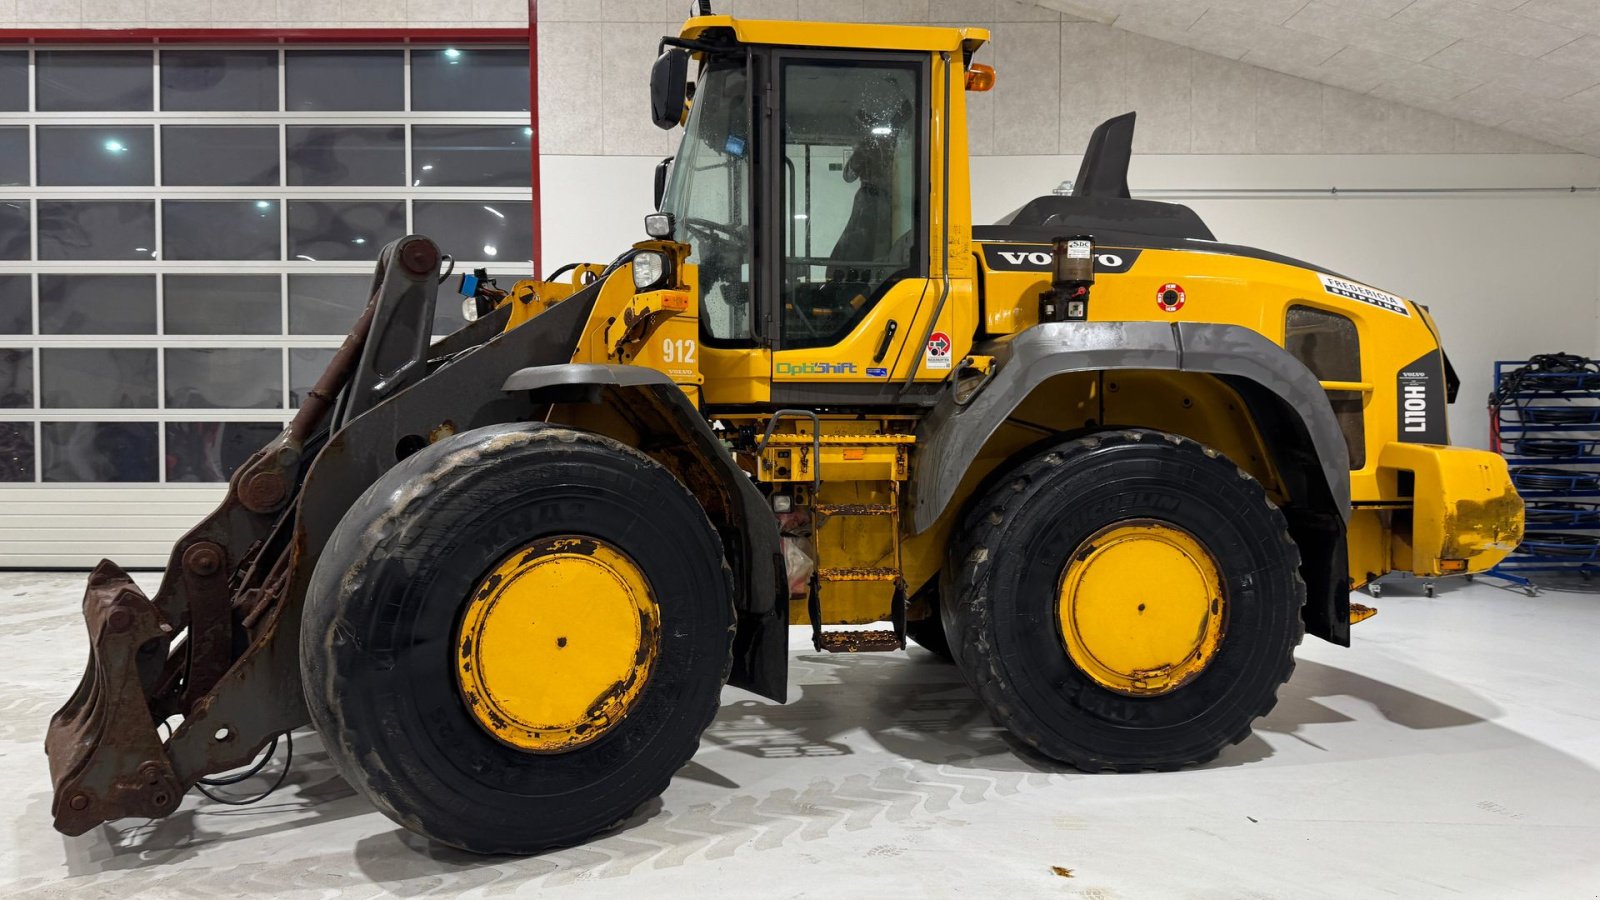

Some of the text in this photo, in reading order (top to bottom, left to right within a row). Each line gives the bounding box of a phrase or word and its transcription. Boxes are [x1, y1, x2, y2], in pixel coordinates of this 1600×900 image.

[997, 251, 1123, 267] VOO
[1328, 278, 1398, 304] FREDERICIA
[1332, 288, 1402, 312] SHIPPING
[663, 338, 696, 363] 912
[776, 362, 857, 375] OptiShift
[1404, 386, 1426, 432] L110H
[1066, 492, 1181, 537] MICHELIN
